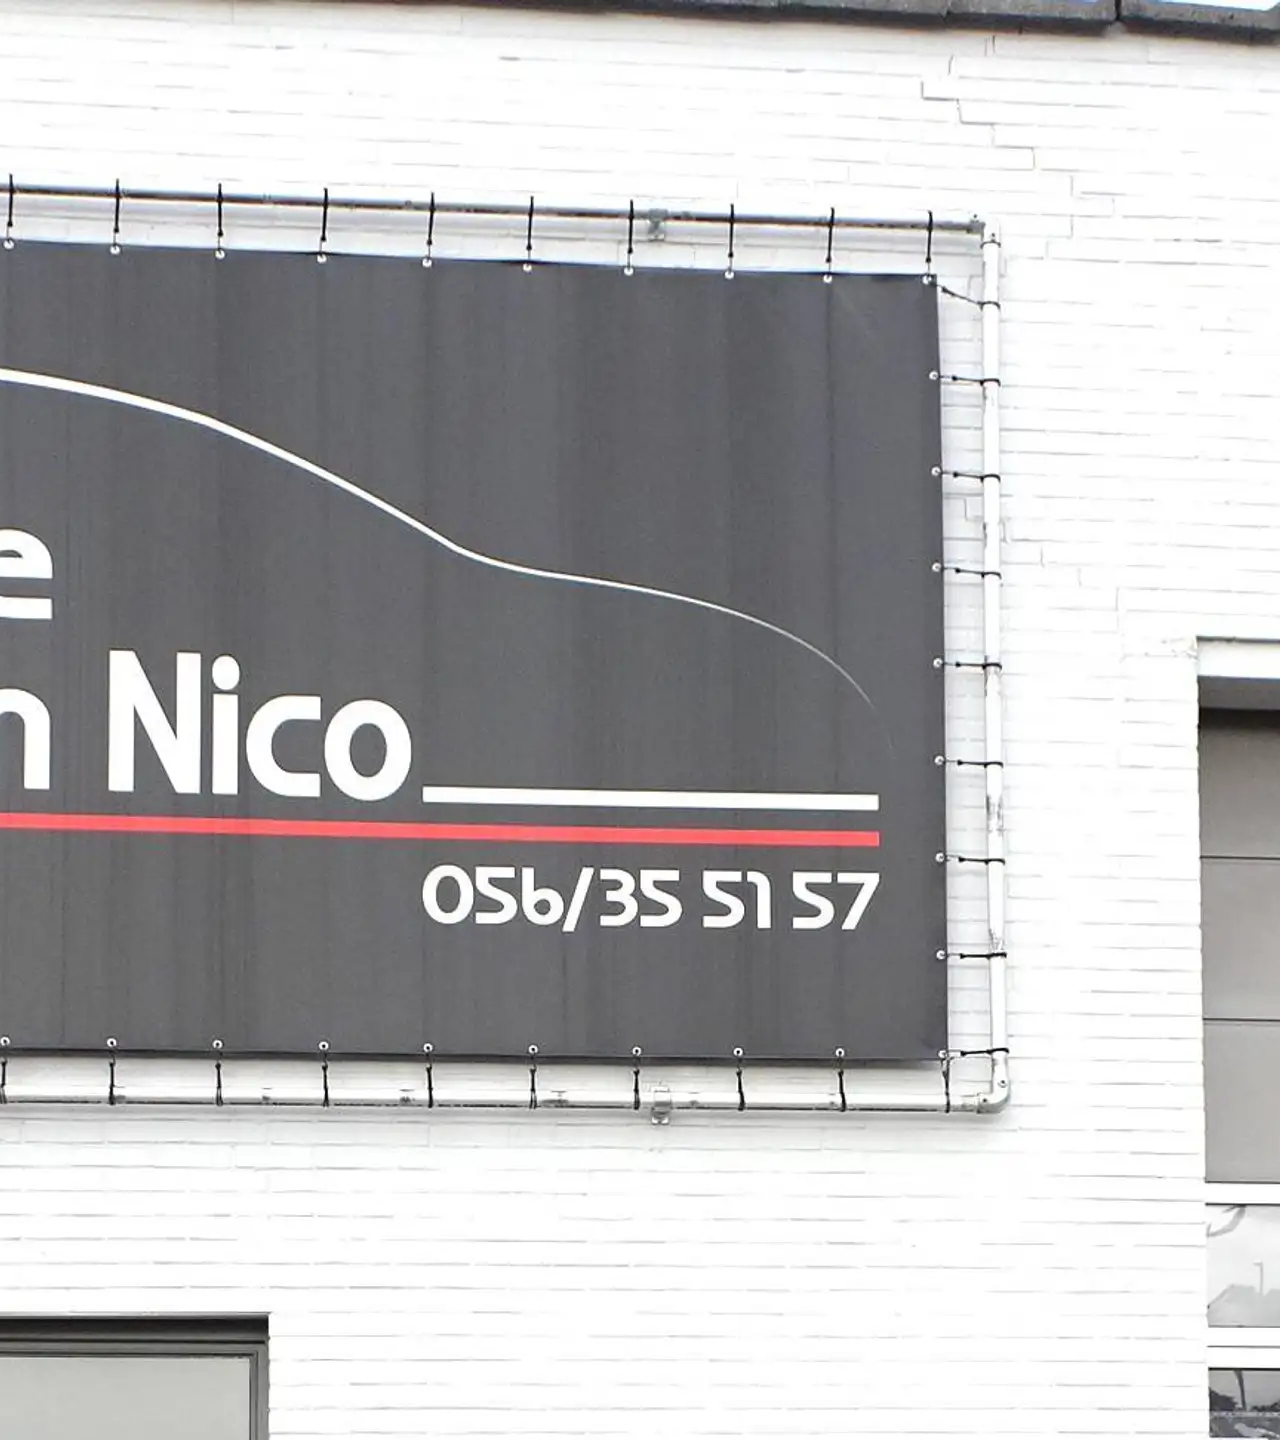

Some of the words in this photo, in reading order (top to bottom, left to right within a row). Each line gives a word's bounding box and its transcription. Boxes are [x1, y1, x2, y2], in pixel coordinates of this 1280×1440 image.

[107, 650, 412, 802] Nico
[422, 864, 683, 933] 056/35
[702, 870, 772, 929] 51
[792, 871, 880, 930] 57
